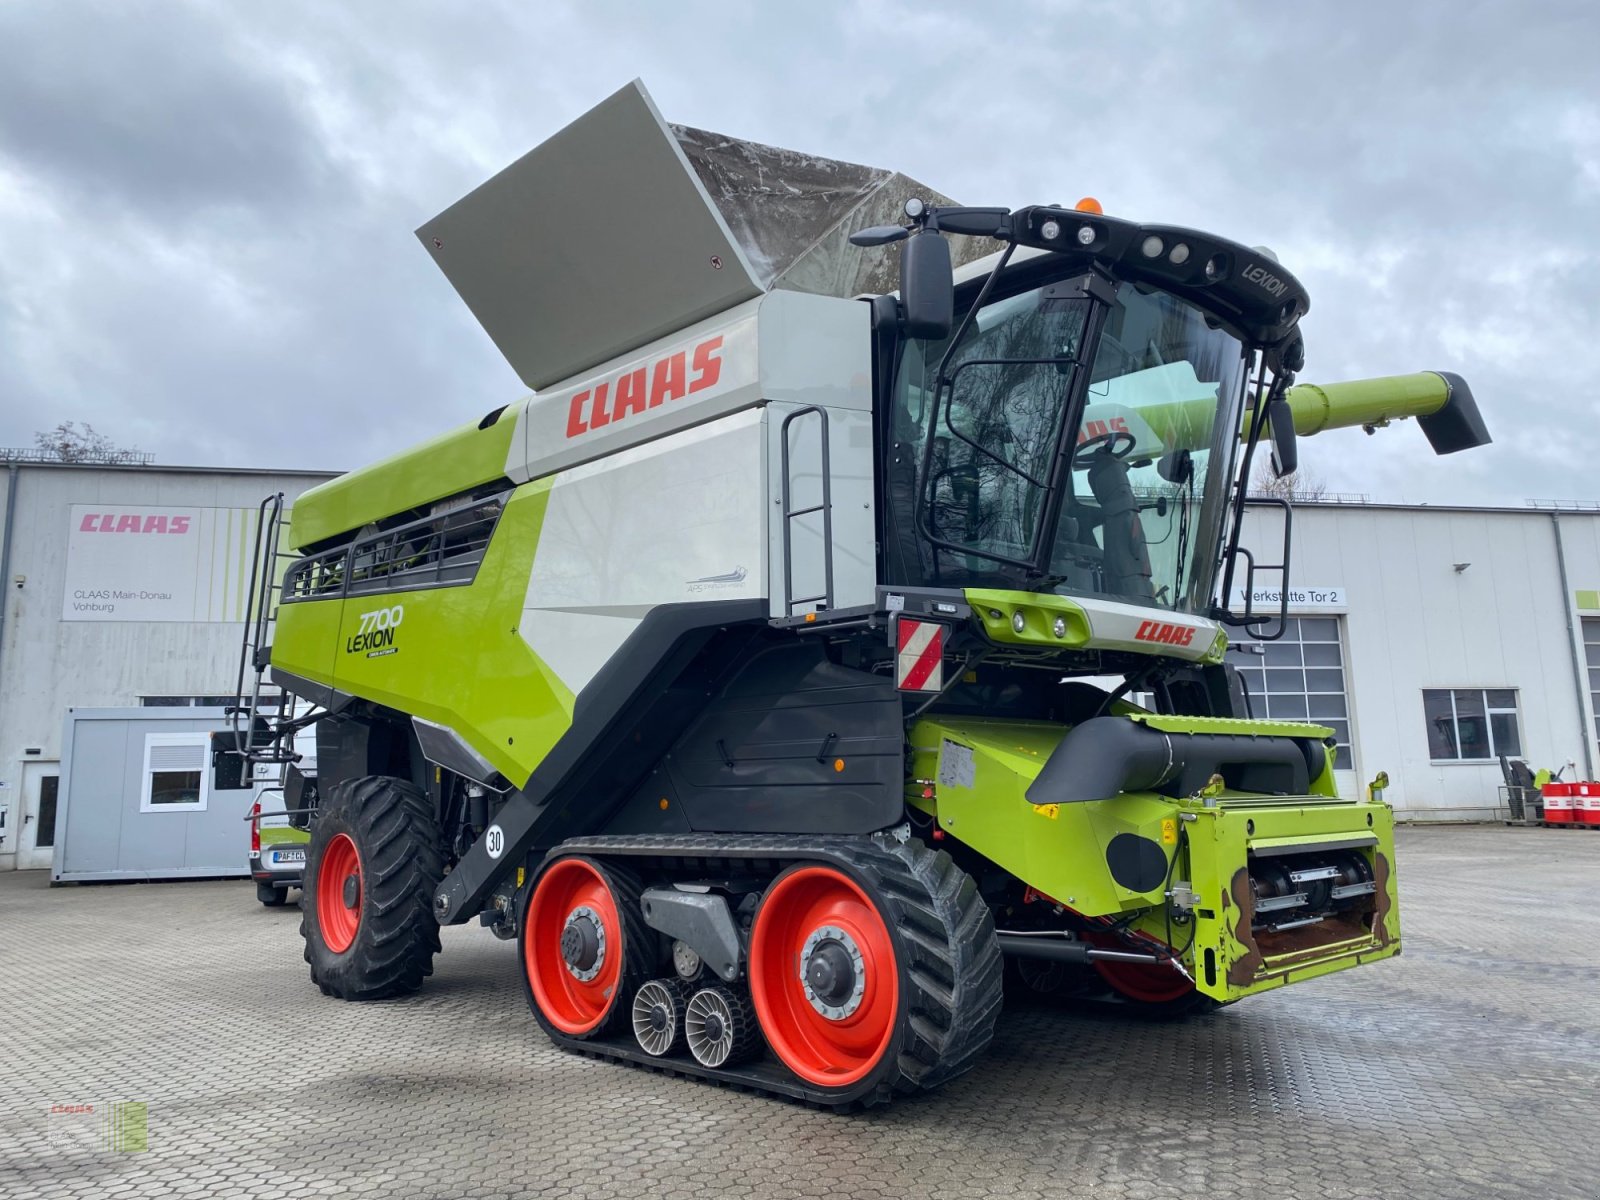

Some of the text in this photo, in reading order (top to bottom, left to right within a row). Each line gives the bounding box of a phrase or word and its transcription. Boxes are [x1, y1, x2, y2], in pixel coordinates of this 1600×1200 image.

[1241, 263, 1289, 297] LEXION
[566, 335, 724, 439] CLAAS
[79, 514, 192, 534] CLAAS
[73, 590, 172, 600] CLAAS Main-Donau
[1240, 590, 1338, 603] erksttte Tor 2
[73, 602, 115, 613] Vohburg
[357, 605, 404, 636] 7700
[346, 627, 395, 654] LEXION
[1135, 621, 1196, 647] CLAAS
[489, 831, 501, 852] 30
